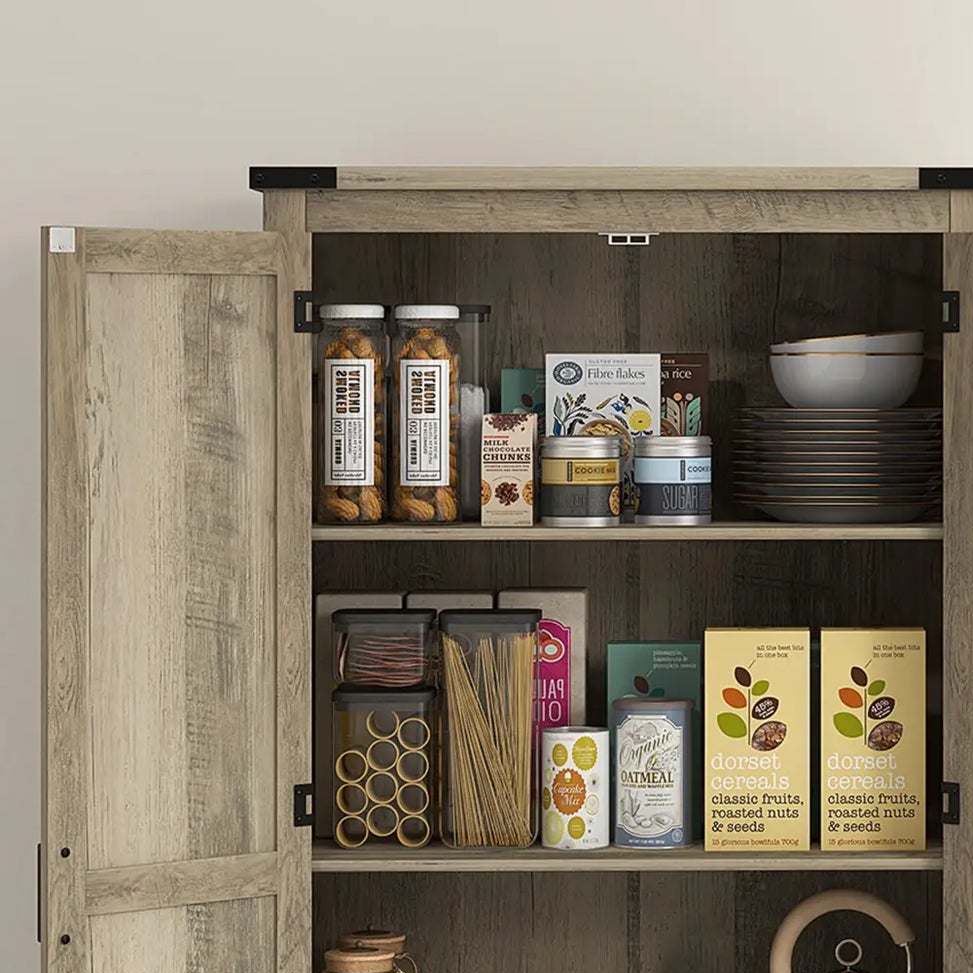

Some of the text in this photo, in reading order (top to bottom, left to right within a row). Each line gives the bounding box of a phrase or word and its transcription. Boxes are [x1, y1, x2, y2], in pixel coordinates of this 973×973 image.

[588, 368, 614, 378] Fibre
[616, 368, 645, 378] flakes
[672, 368, 692, 378] rice
[662, 485, 698, 510] SUGAR
[620, 729, 672, 768] Organic
[711, 752, 781, 770] dorset
[827, 752, 897, 770] dorset
[620, 770, 674, 784] OATMEAL
[711, 773, 790, 790] cereals
[827, 772, 905, 790] cereals
[554, 783, 584, 797] Cupcake
[712, 793, 804, 806] classic fruits,
[828, 793, 920, 806] classic fruits,
[712, 807, 799, 818] roasted nuts
[828, 807, 915, 818] roasted nuts
[712, 821, 765, 832] & seeds
[828, 821, 881, 832] & seeds
